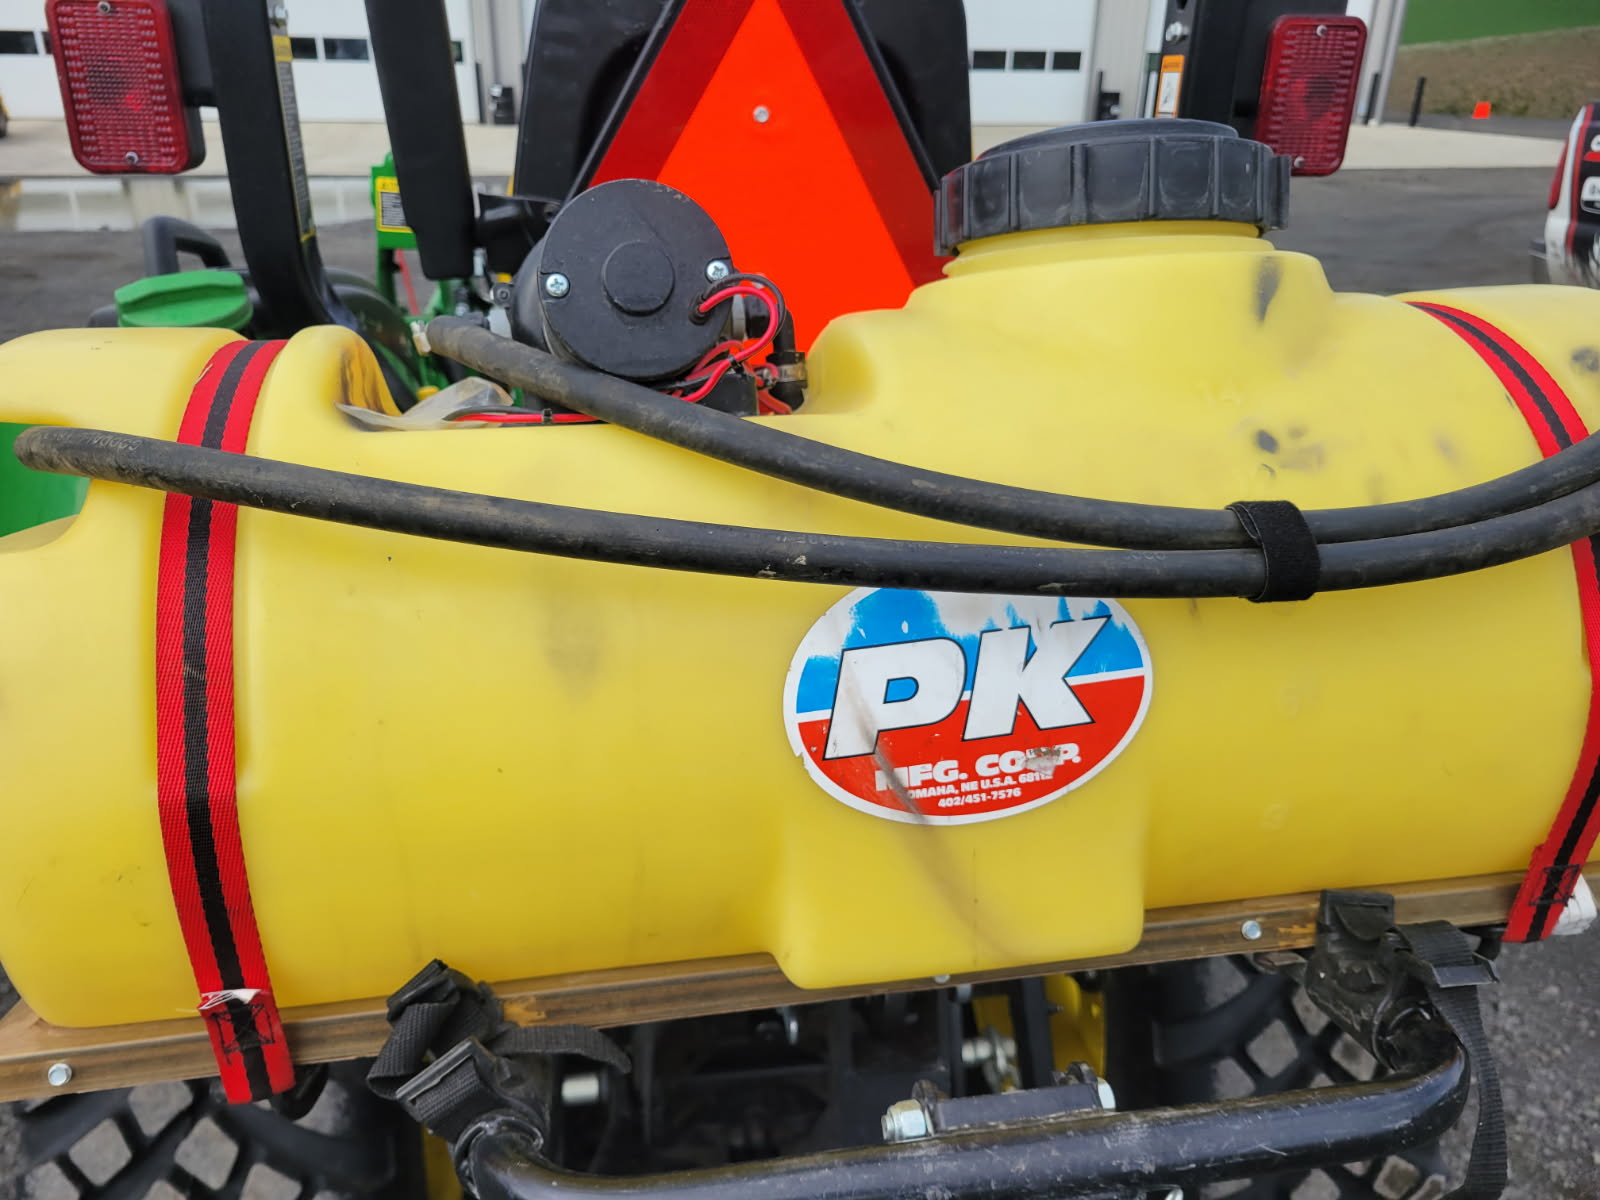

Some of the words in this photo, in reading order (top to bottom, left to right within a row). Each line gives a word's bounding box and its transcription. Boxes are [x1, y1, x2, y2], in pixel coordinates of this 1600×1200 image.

[822, 614, 1112, 760] PK
[874, 759, 968, 792] MFG.
[907, 784, 959, 799] OMAHA,
[961, 781, 979, 792] NE
[980, 777, 1017, 790] U.S.A.
[937, 787, 1022, 808] 402/451-7576
